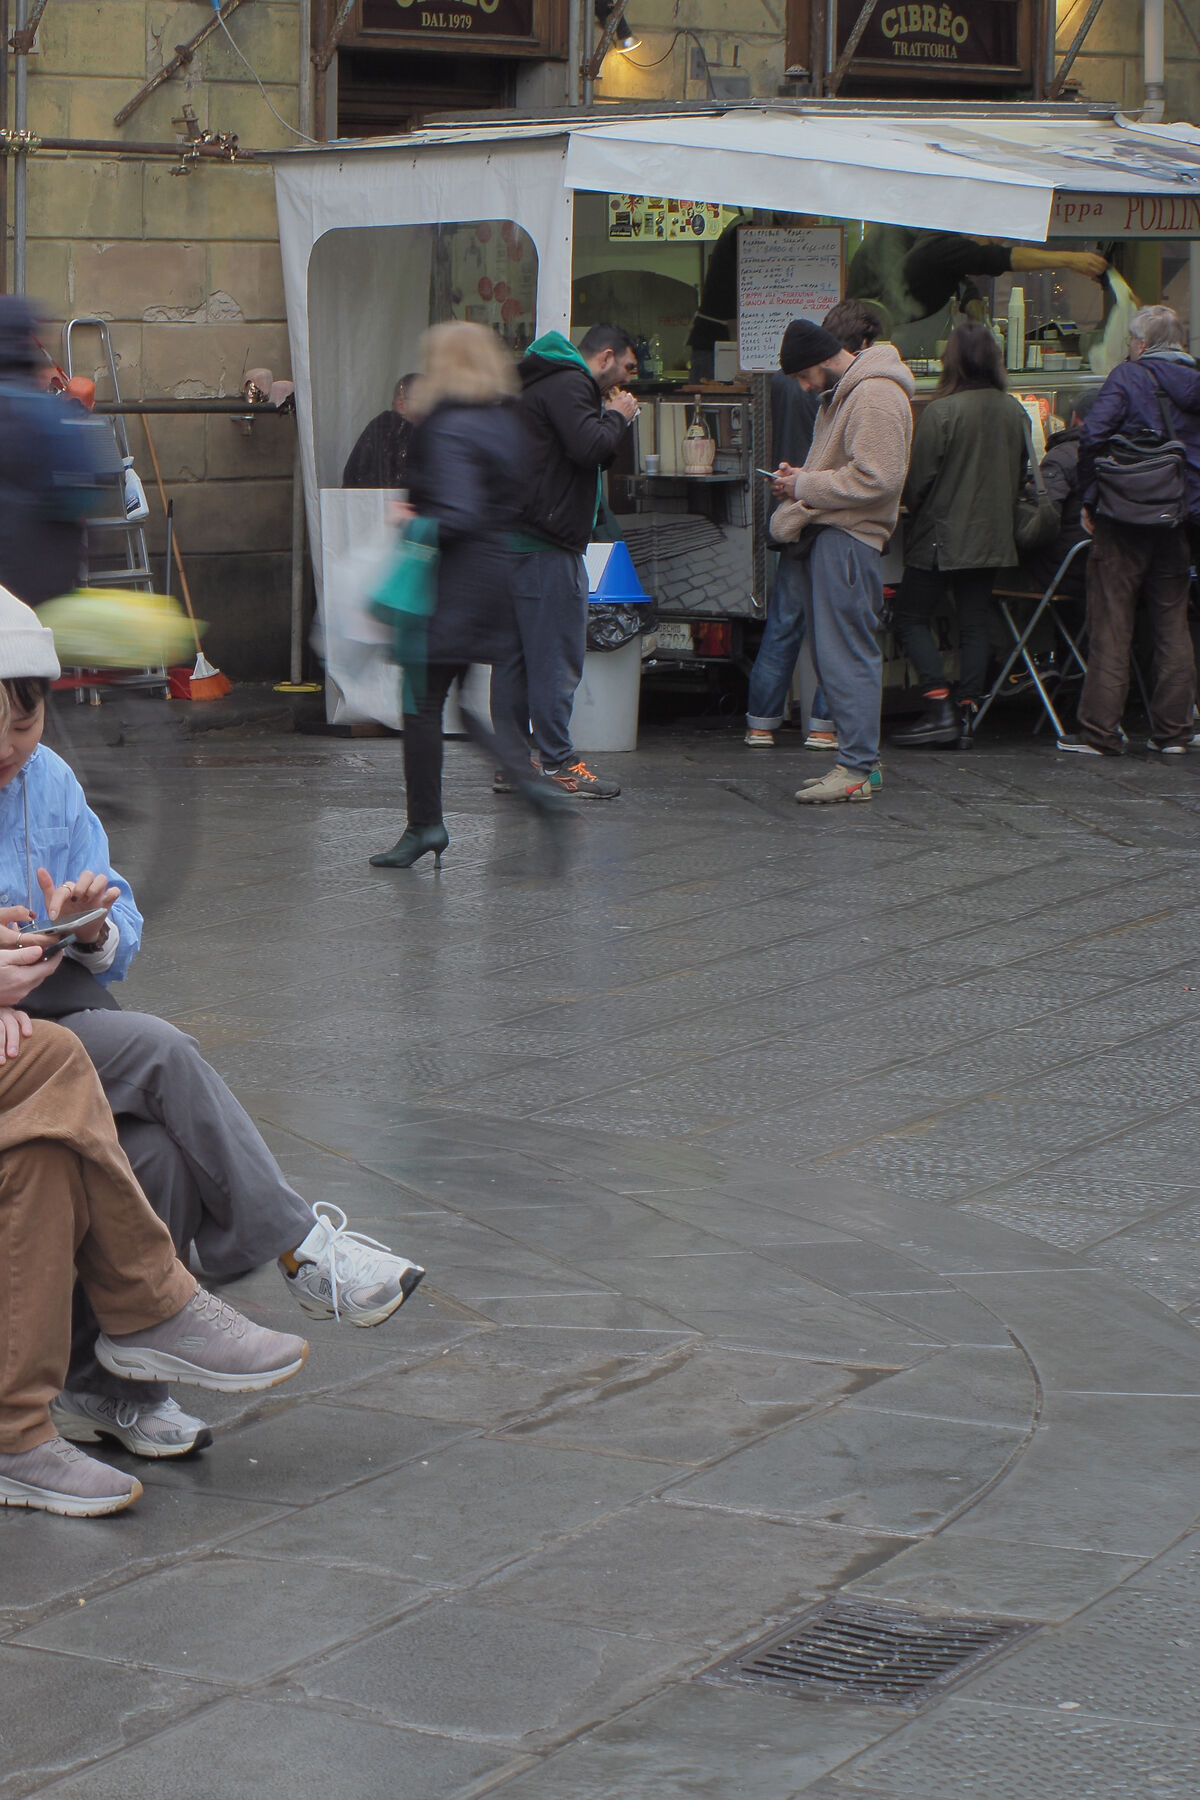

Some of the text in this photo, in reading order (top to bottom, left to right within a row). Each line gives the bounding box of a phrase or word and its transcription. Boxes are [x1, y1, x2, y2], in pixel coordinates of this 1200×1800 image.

[421, 12, 473, 29] DAL 1979
[881, 3, 969, 44] CIBRÈO
[892, 41, 958, 59] TRATTORIA
